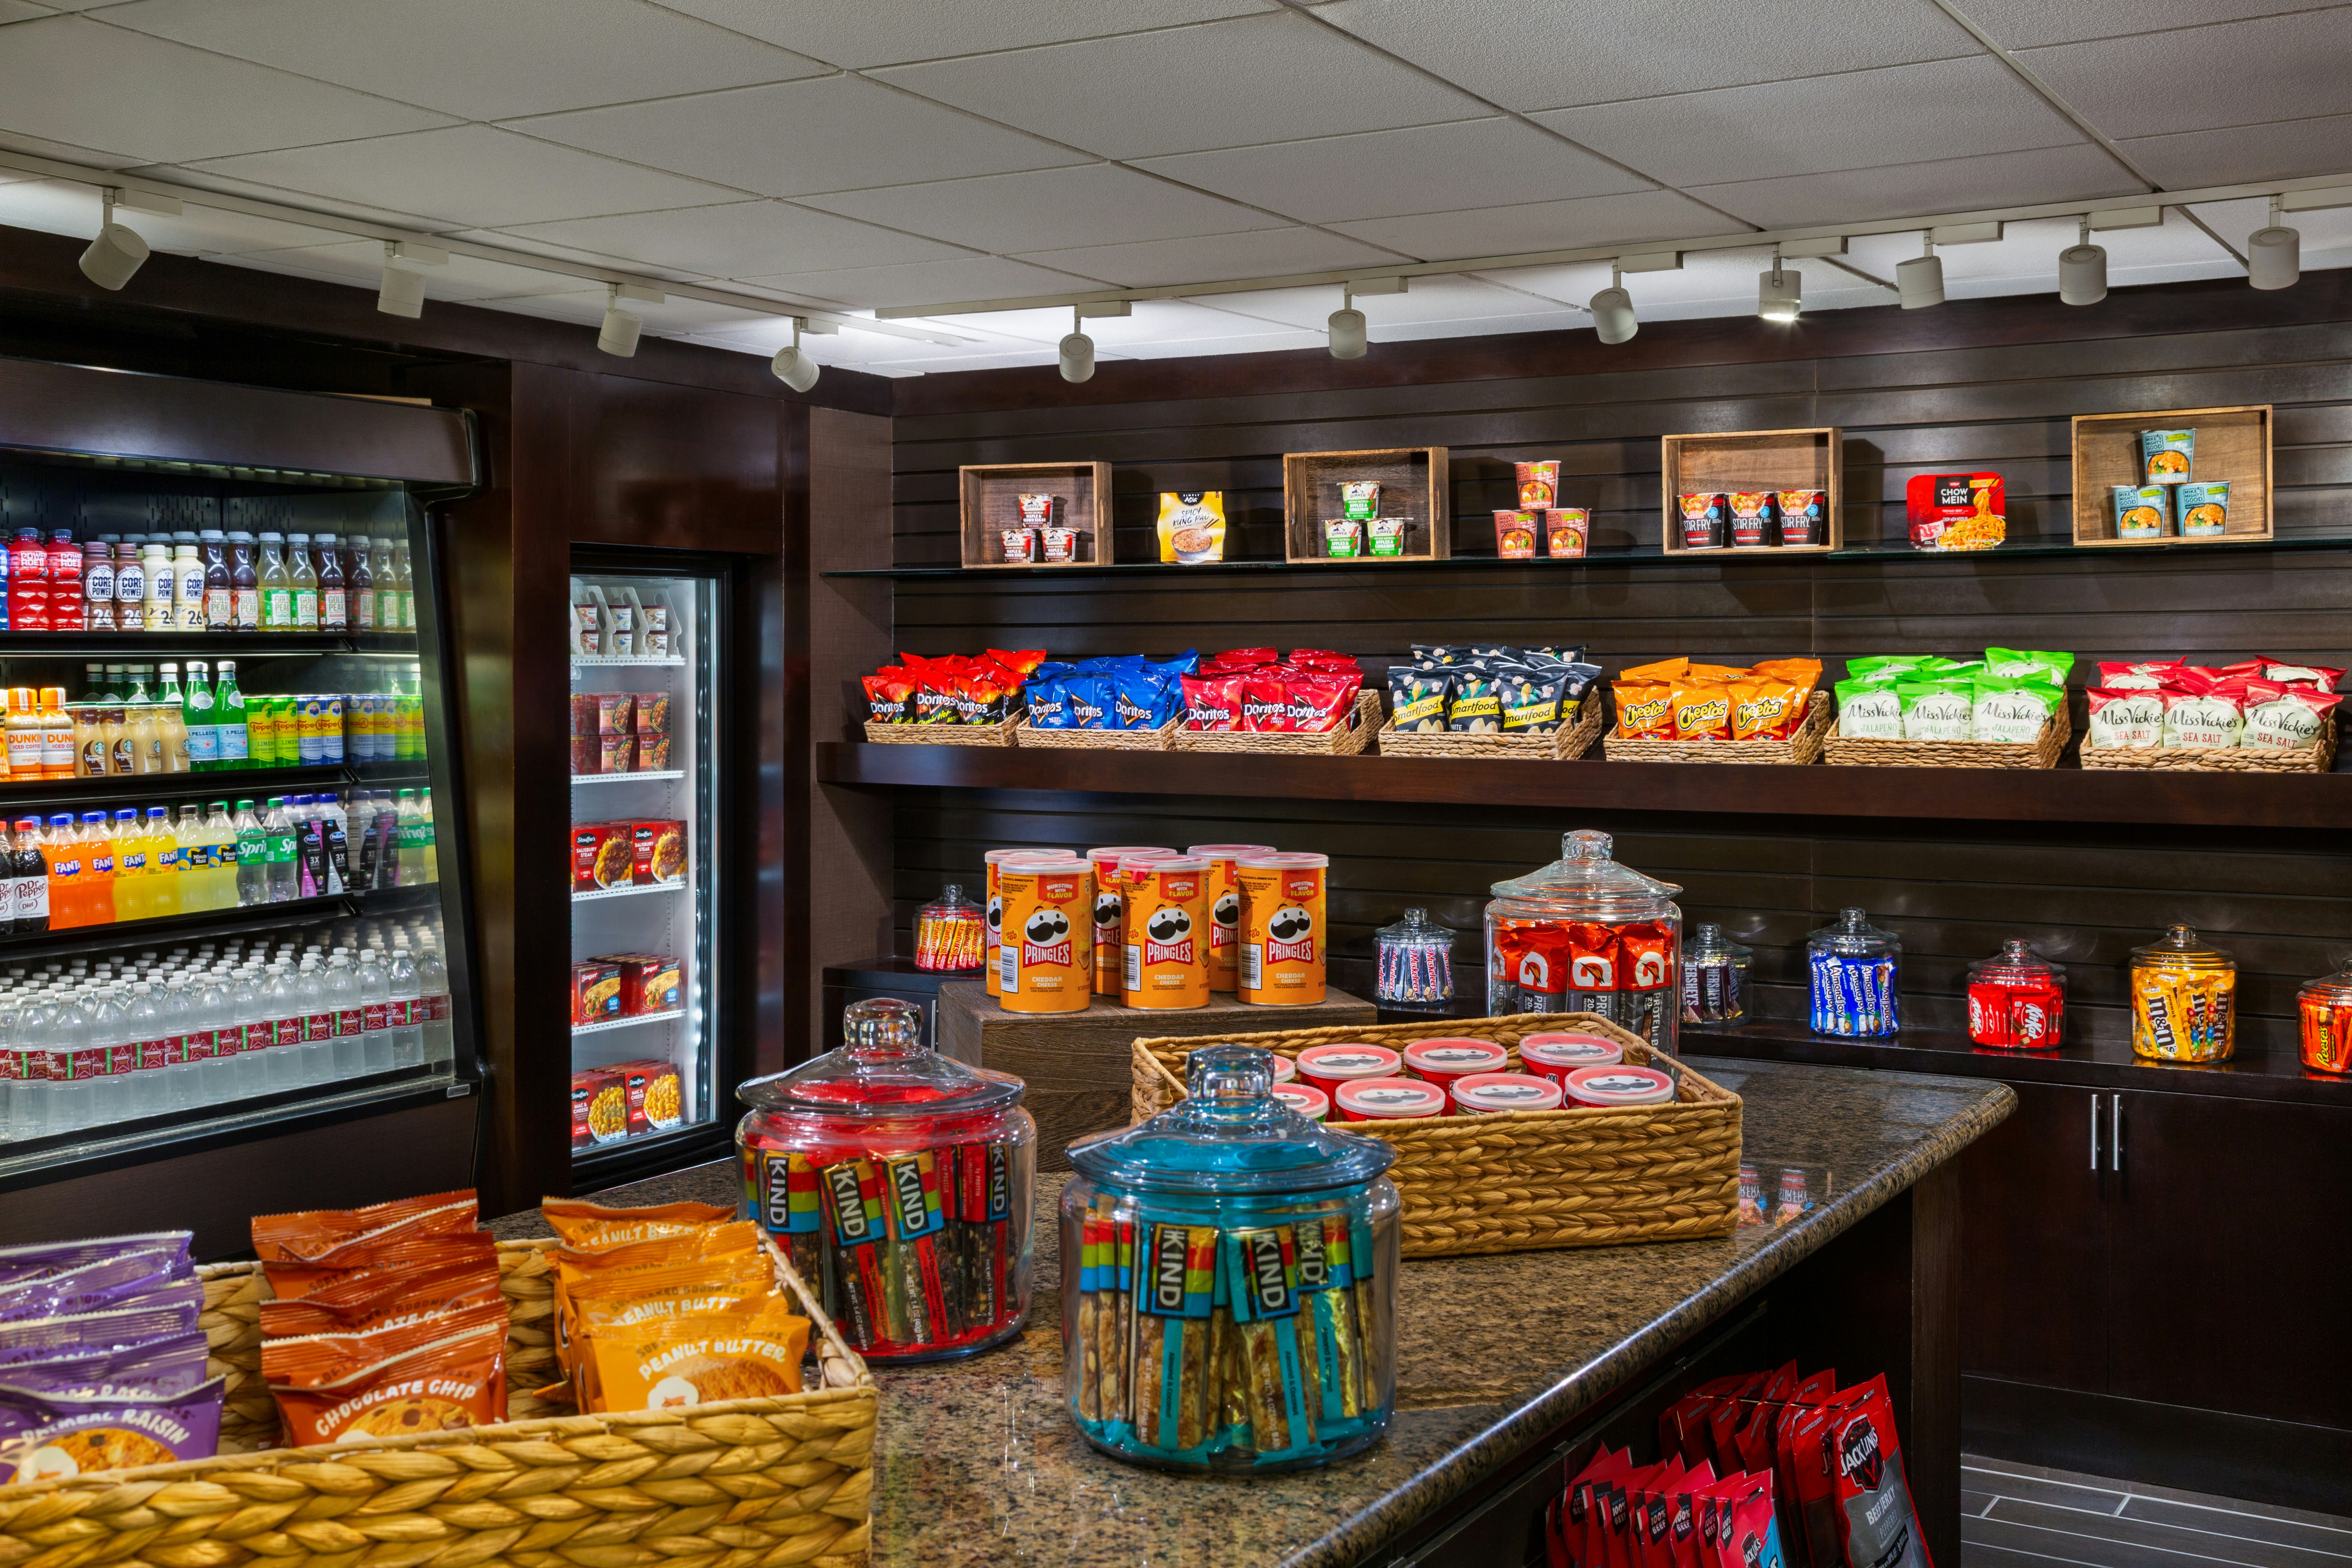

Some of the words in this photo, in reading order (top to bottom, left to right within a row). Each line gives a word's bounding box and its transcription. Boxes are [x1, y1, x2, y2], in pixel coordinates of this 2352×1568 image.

[1942, 496, 1967, 504] MEIN
[1182, 507, 1201, 517] SPICY
[1173, 518, 1192, 527] KUNG
[1195, 513, 1209, 522] PAO
[1684, 520, 1695, 531] STIR
[1697, 519, 1710, 530] FRY
[1749, 518, 1761, 529] FRY
[93, 577, 111, 587] CORE
[122, 577, 142, 587] CORE
[187, 579, 203, 589] CORE
[93, 588, 111, 596] POWER
[240, 595, 256, 604] GOLD
[300, 595, 316, 604] GOLD
[188, 610, 202, 624] 26
[917, 693, 956, 706] Doritos
[870, 702, 904, 713] Doritos
[938, 710, 951, 719] Hot
[1116, 701, 1152, 719] Doritos
[1189, 708, 1229, 720] Doritos
[1244, 703, 1285, 716] Doritos
[1287, 704, 1327, 718] Doritos
[1394, 700, 1439, 722] Smartfood
[1451, 700, 1497, 716] Smartfood
[1624, 700, 1666, 728] Cheetos
[1737, 699, 1782, 730] Cheetos
[1912, 706, 1940, 720] Miss
[1679, 700, 1728, 730] Cheetos
[2198, 710, 2238, 732] Vickie's
[1635, 719, 1657, 729] Crunchy
[1692, 719, 1716, 732] Crunchy
[1860, 724, 1897, 732] JALAPEÑO
[1924, 725, 1961, 734] JALAPEÑO
[1992, 724, 2030, 734] JALAPEÑO
[2115, 731, 2129, 740] SEA
[2132, 730, 2150, 739] SALT
[2183, 732, 2198, 742] SEA
[2202, 734, 2222, 744] SALT
[2257, 732, 2273, 744] SEA
[2276, 737, 2297, 748] SALT
[336, 853, 345, 861] 3X
[15, 883, 45, 899] Pepper
[27, 880, 38, 889] Dr
[1025, 944, 1070, 964] PRINGLES
[1147, 942, 1191, 963] PRINGLES
[1269, 941, 1312, 962] PRINGLES
[1410, 954, 1420, 994] Musketeers
[1426, 952, 1437, 992] Musketeers
[1572, 956, 1612, 987] G
[1635, 951, 1664, 987] G
[581, 973, 597, 982] Banquet
[1685, 963, 1699, 1006] HERSHEY'S
[1653, 992, 1662, 1029] PROTEIN
[2167, 994, 2176, 1018] peanut
[2147, 996, 2176, 1054] m&m's
[2316, 1025, 2330, 1067] Reese's
[769, 1158, 786, 1225] KIND
[896, 1163, 926, 1230] KIND
[833, 1170, 866, 1237] KIND
[855, 1316, 862, 1324] OZ
[639, 1341, 710, 1380] PEANUT
[714, 1339, 786, 1363] BUTTER
[1285, 1350, 1294, 1378] Almond
[1290, 1386, 1298, 1417] Coconut
[315, 1380, 424, 1436] CHOCOLATE
[429, 1379, 477, 1400] CHIP
[21, 1412, 114, 1443] OATMEAL
[121, 1409, 190, 1444] RAISIN
[1841, 1446, 1866, 1477] JACK
[1880, 1484, 1895, 1514] JERKY
[1613, 1501, 1626, 1516] 100%
[1614, 1512, 1626, 1525] BEEF
[1677, 1519, 1690, 1532] BEEF
[1879, 1509, 1898, 1540] PEPPERED
